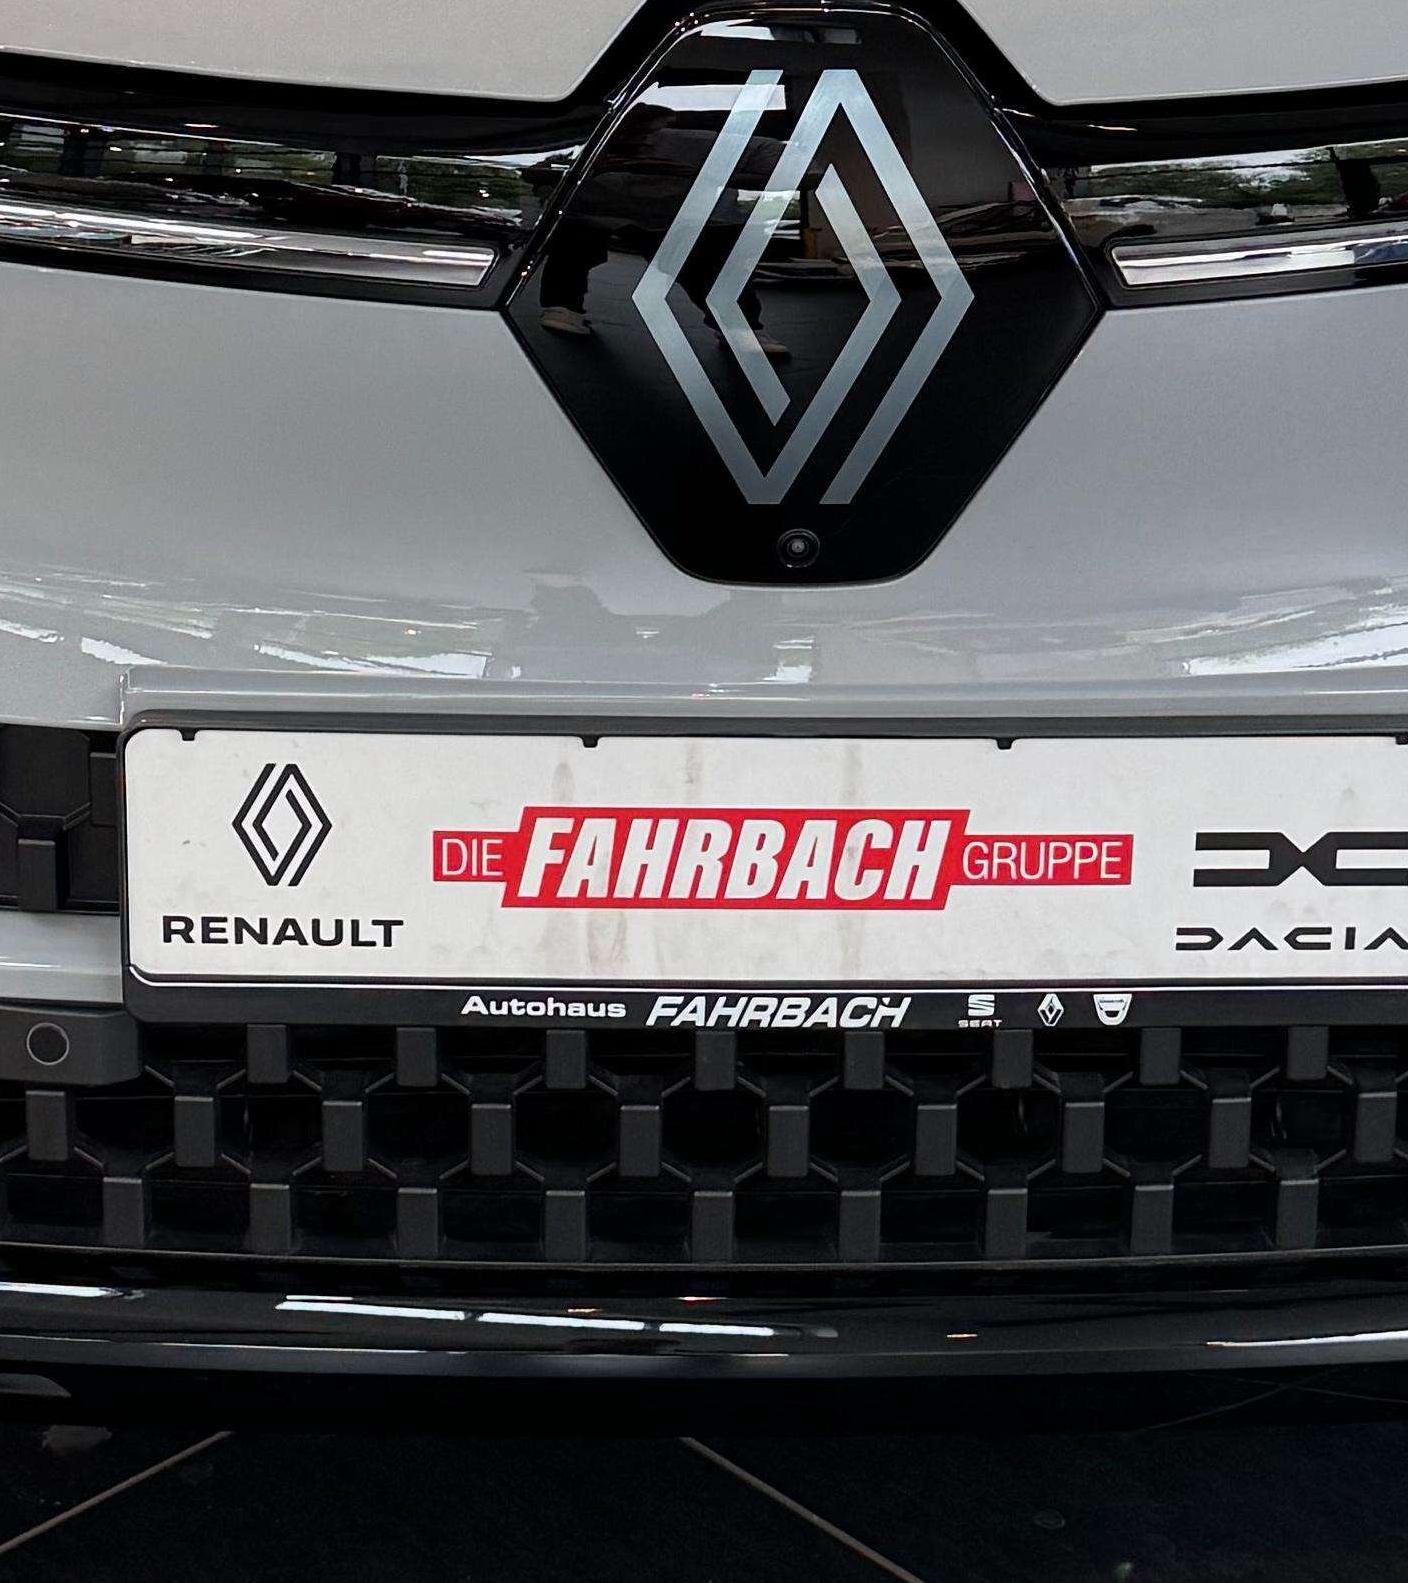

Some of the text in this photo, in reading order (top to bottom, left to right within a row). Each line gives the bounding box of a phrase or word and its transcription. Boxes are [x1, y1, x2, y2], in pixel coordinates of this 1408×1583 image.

[442, 817, 1124, 901] DIE FAHRBACH GRUPPE
[162, 915, 404, 948] RENAULT
[460, 995, 912, 1028] Autohaus FAHRBACH
[958, 1019, 1003, 1029] SEAT
